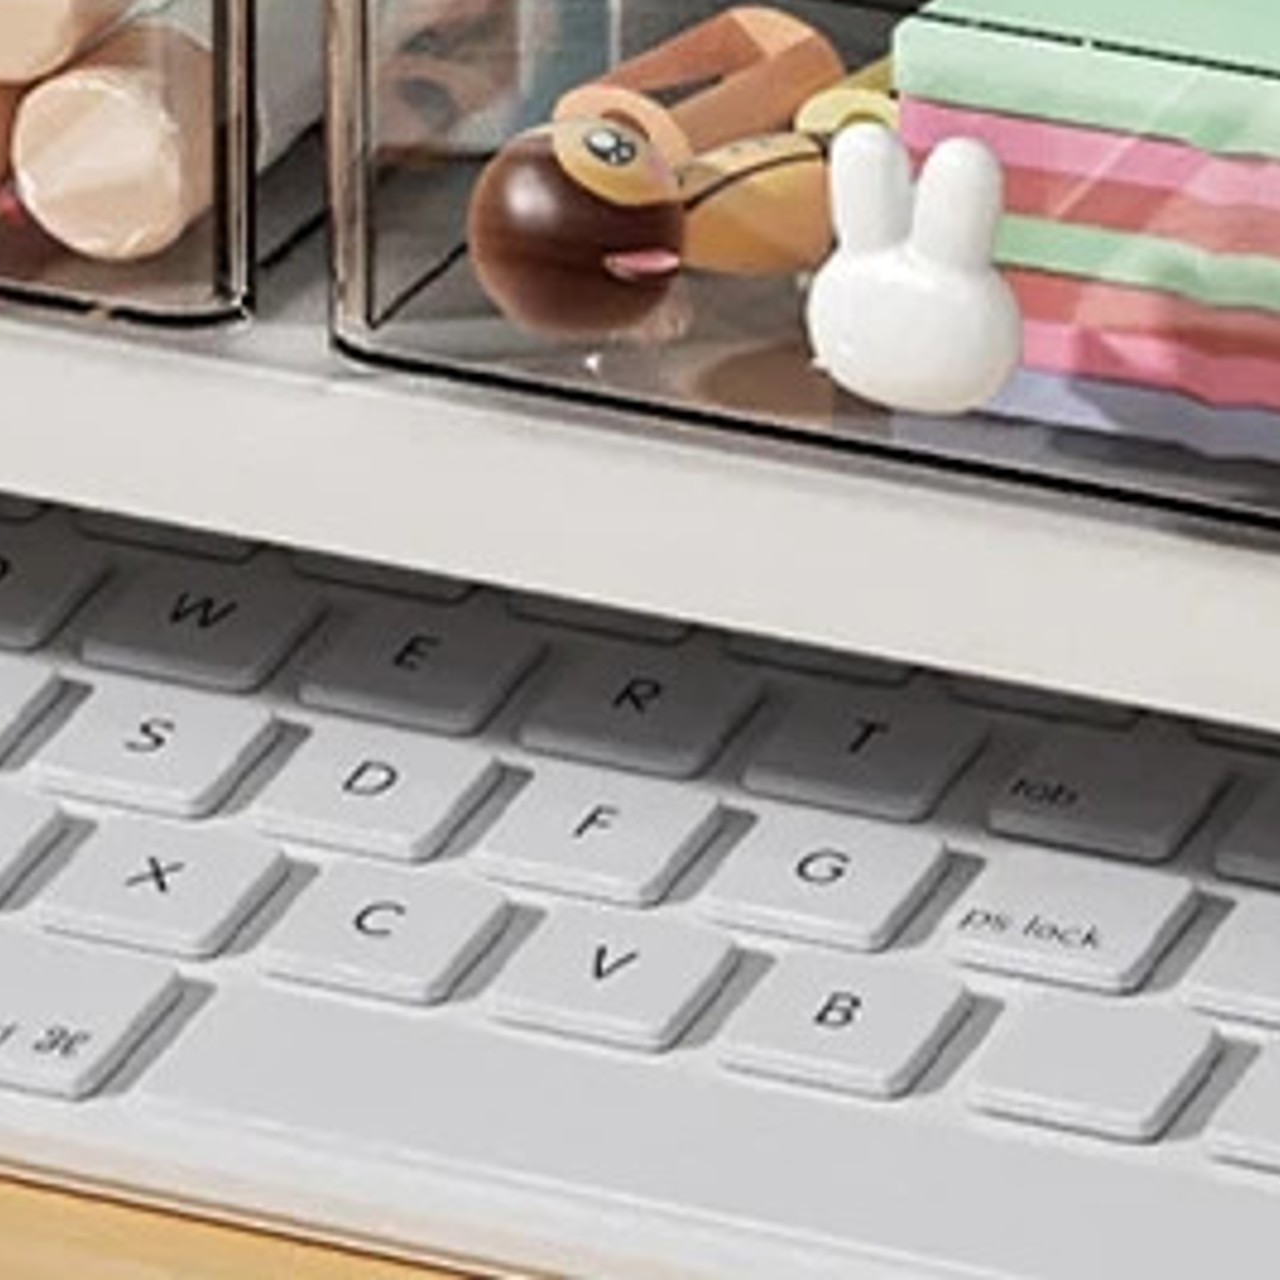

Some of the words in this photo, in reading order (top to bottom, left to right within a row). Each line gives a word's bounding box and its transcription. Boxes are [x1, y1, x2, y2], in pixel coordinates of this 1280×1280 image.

[169, 592, 238, 629] W
[393, 635, 439, 670] E
[613, 677, 663, 713] R
[125, 719, 176, 752] S
[849, 720, 889, 754] T
[342, 760, 398, 796] D
[574, 804, 619, 837] F
[125, 856, 184, 893] X
[795, 849, 851, 885] G
[353, 901, 407, 937] C
[1022, 913, 1102, 950] lock
[592, 945, 640, 981] V
[813, 992, 863, 1028] B
